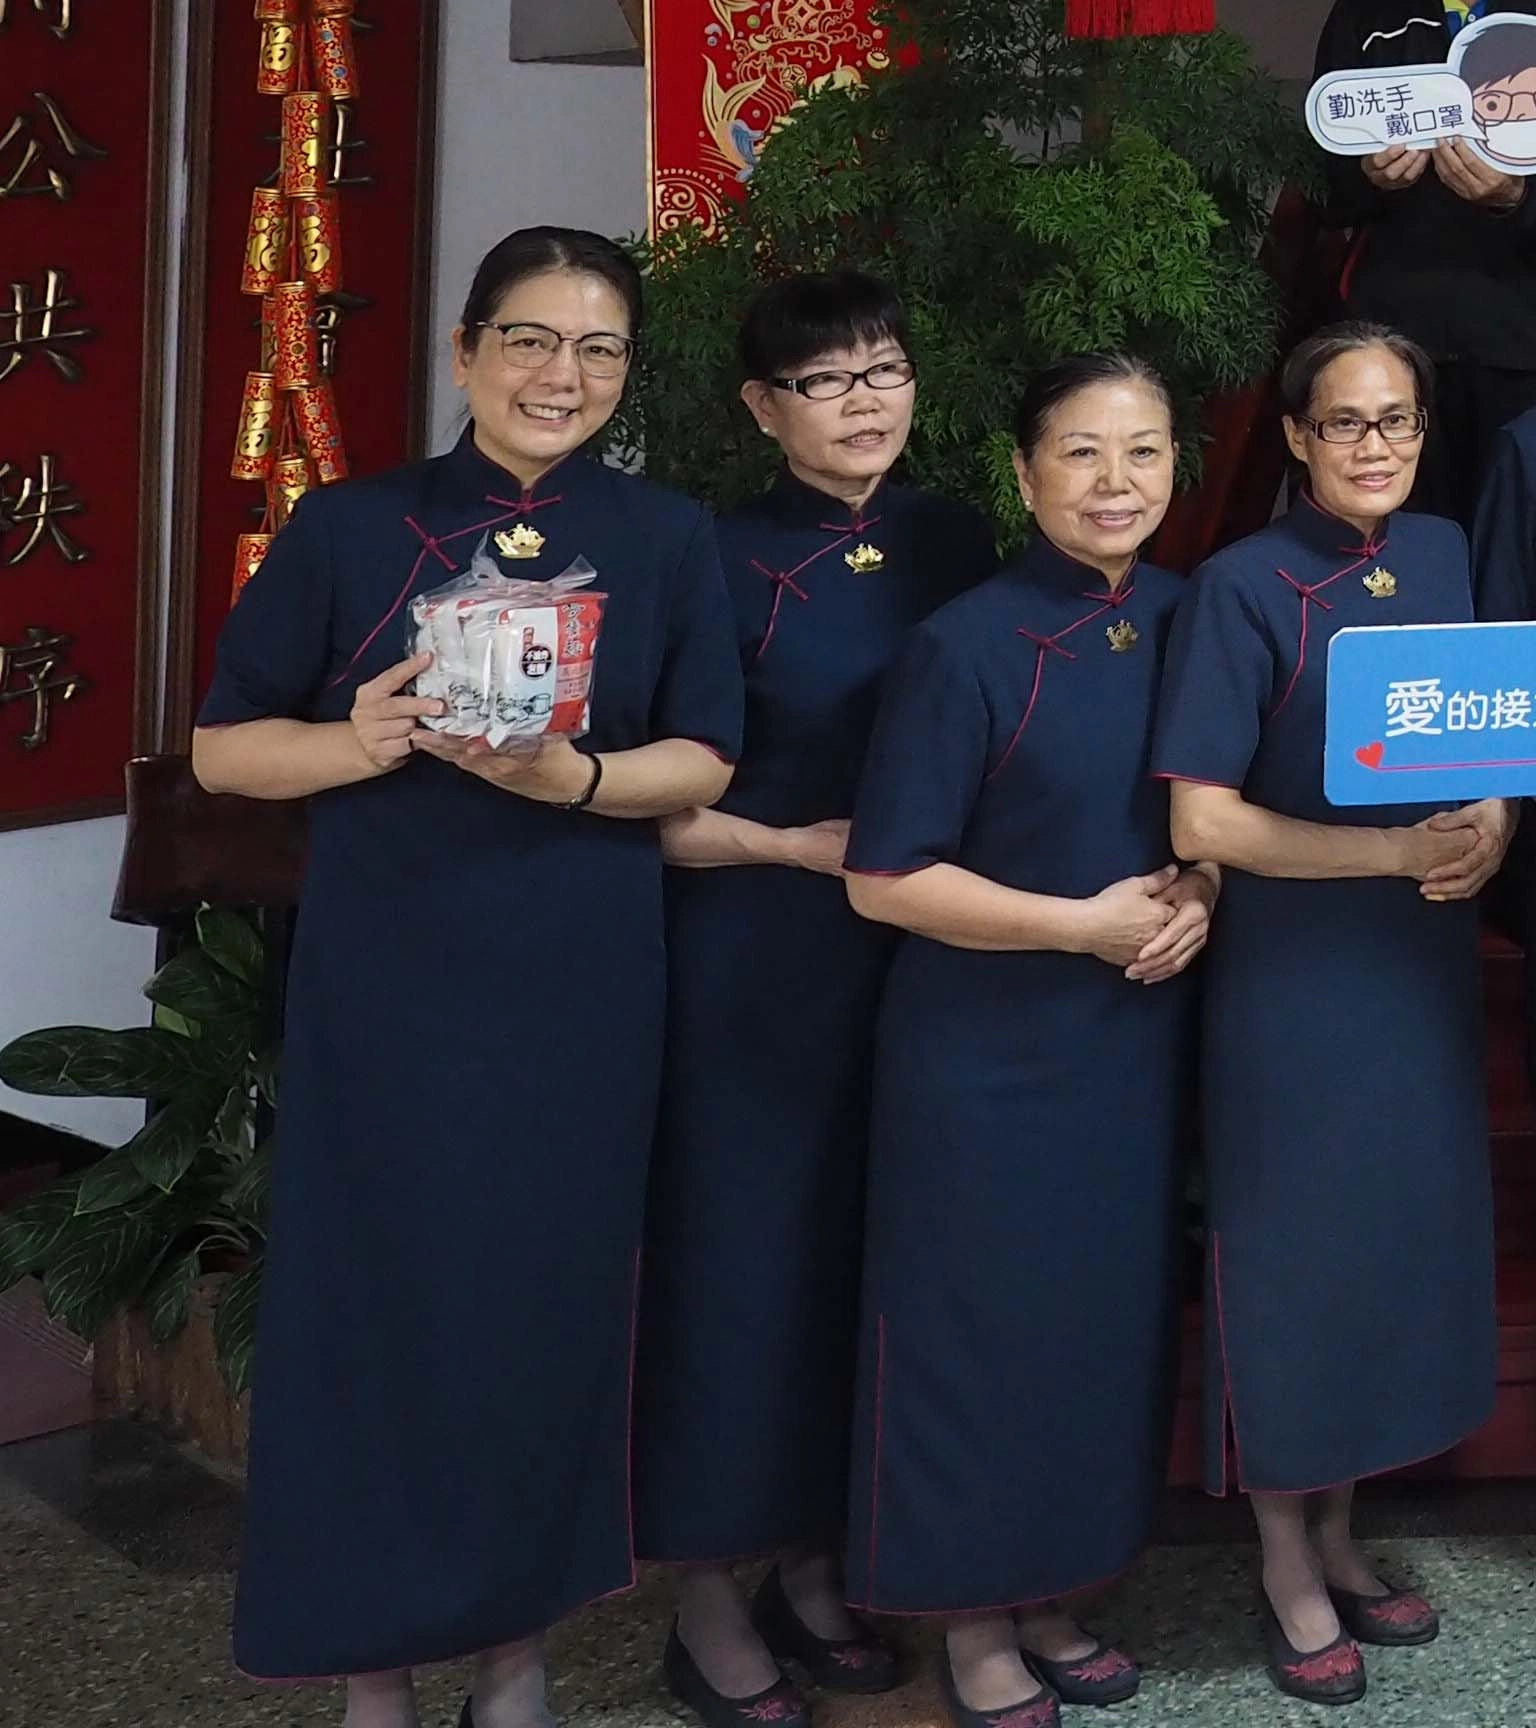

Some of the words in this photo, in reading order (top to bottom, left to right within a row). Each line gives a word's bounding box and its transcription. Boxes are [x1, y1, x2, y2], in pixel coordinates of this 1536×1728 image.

[1327, 82, 1414, 121] 勤洗手
[1384, 102, 1466, 139] 戴口罩
